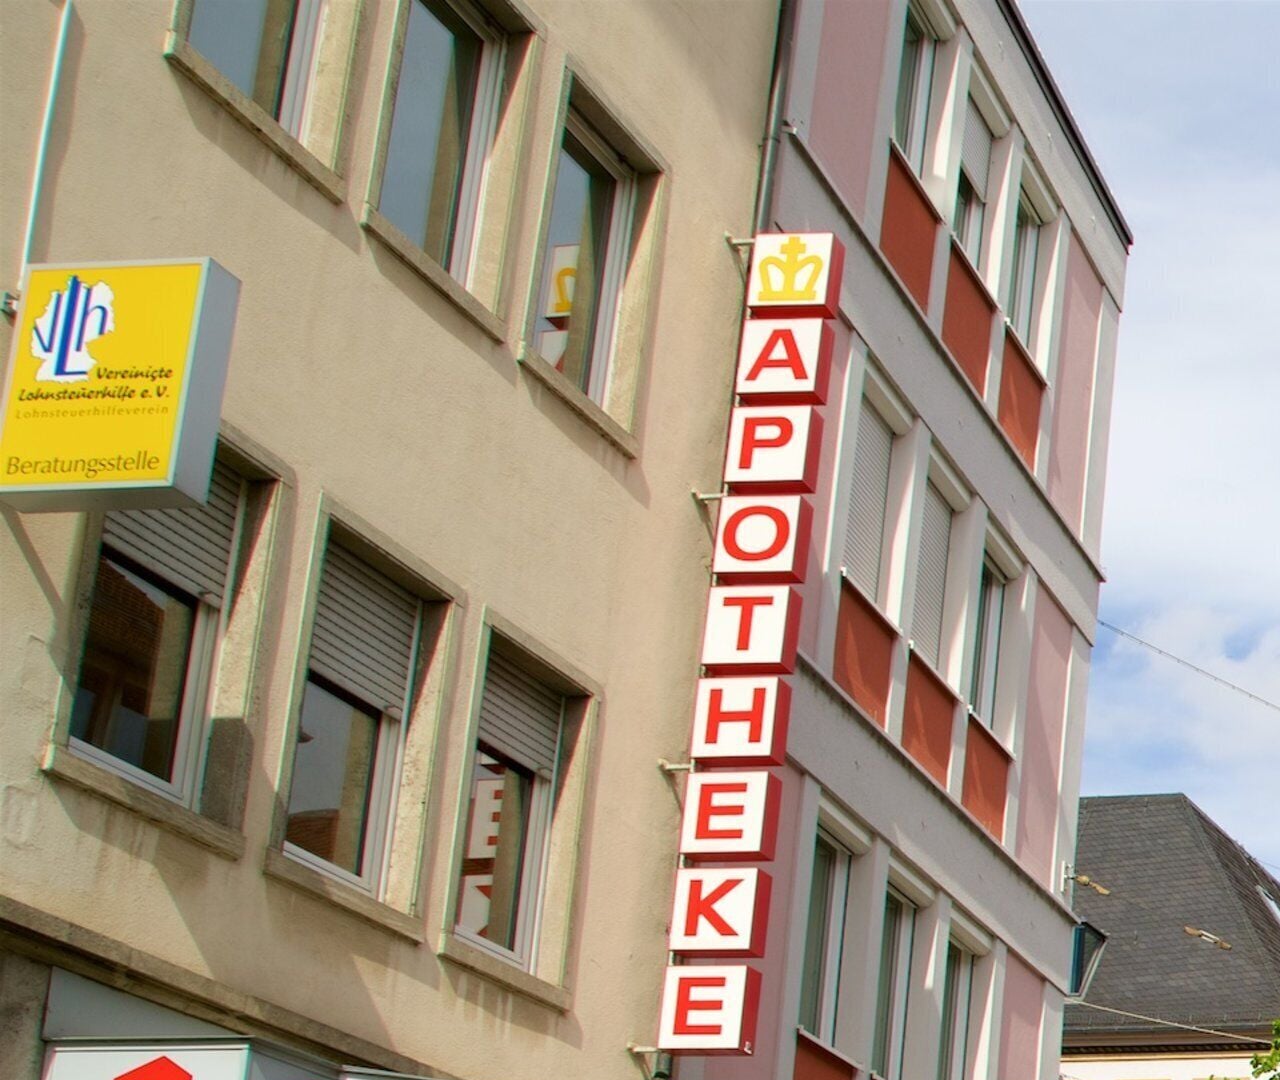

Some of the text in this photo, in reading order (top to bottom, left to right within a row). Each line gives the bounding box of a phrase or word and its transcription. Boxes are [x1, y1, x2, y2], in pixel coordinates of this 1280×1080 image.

[96, 366, 173, 380] Vereinigte
[140, 387, 152, 399] e.
[156, 385, 170, 398] V.
[15, 405, 169, 419] Lohnsteuerhilfeverein
[6, 450, 160, 479] Beratungsstelle
[672, 329, 808, 1035] APOTHEKE
